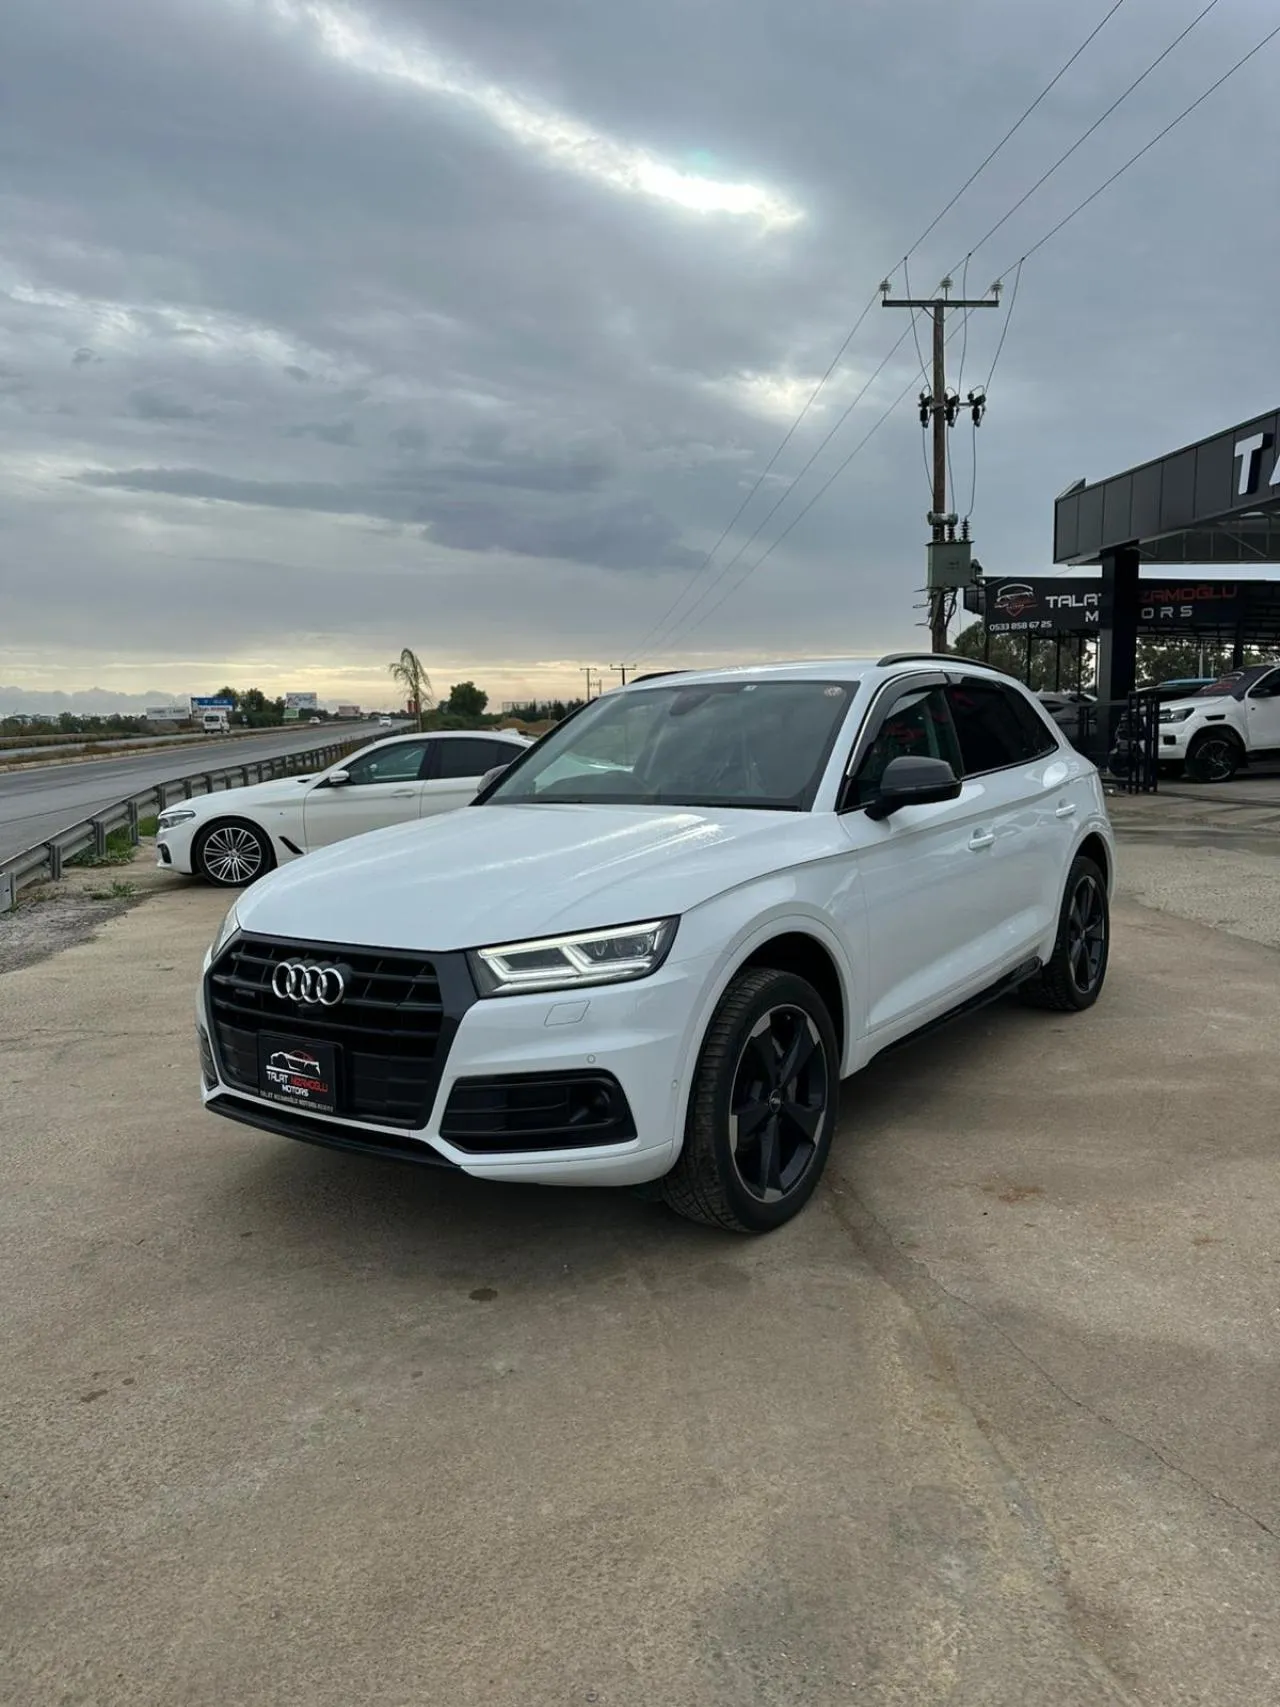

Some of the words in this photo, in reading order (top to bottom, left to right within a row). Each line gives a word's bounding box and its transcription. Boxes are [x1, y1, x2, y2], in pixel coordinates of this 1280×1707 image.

[1045, 593, 1102, 608] TALA
[989, 622, 1009, 631] 0533
[1029, 621, 1040, 629] 67
[266, 1071, 288, 1084] TALAT
[282, 1084, 309, 1097] MOTORS
